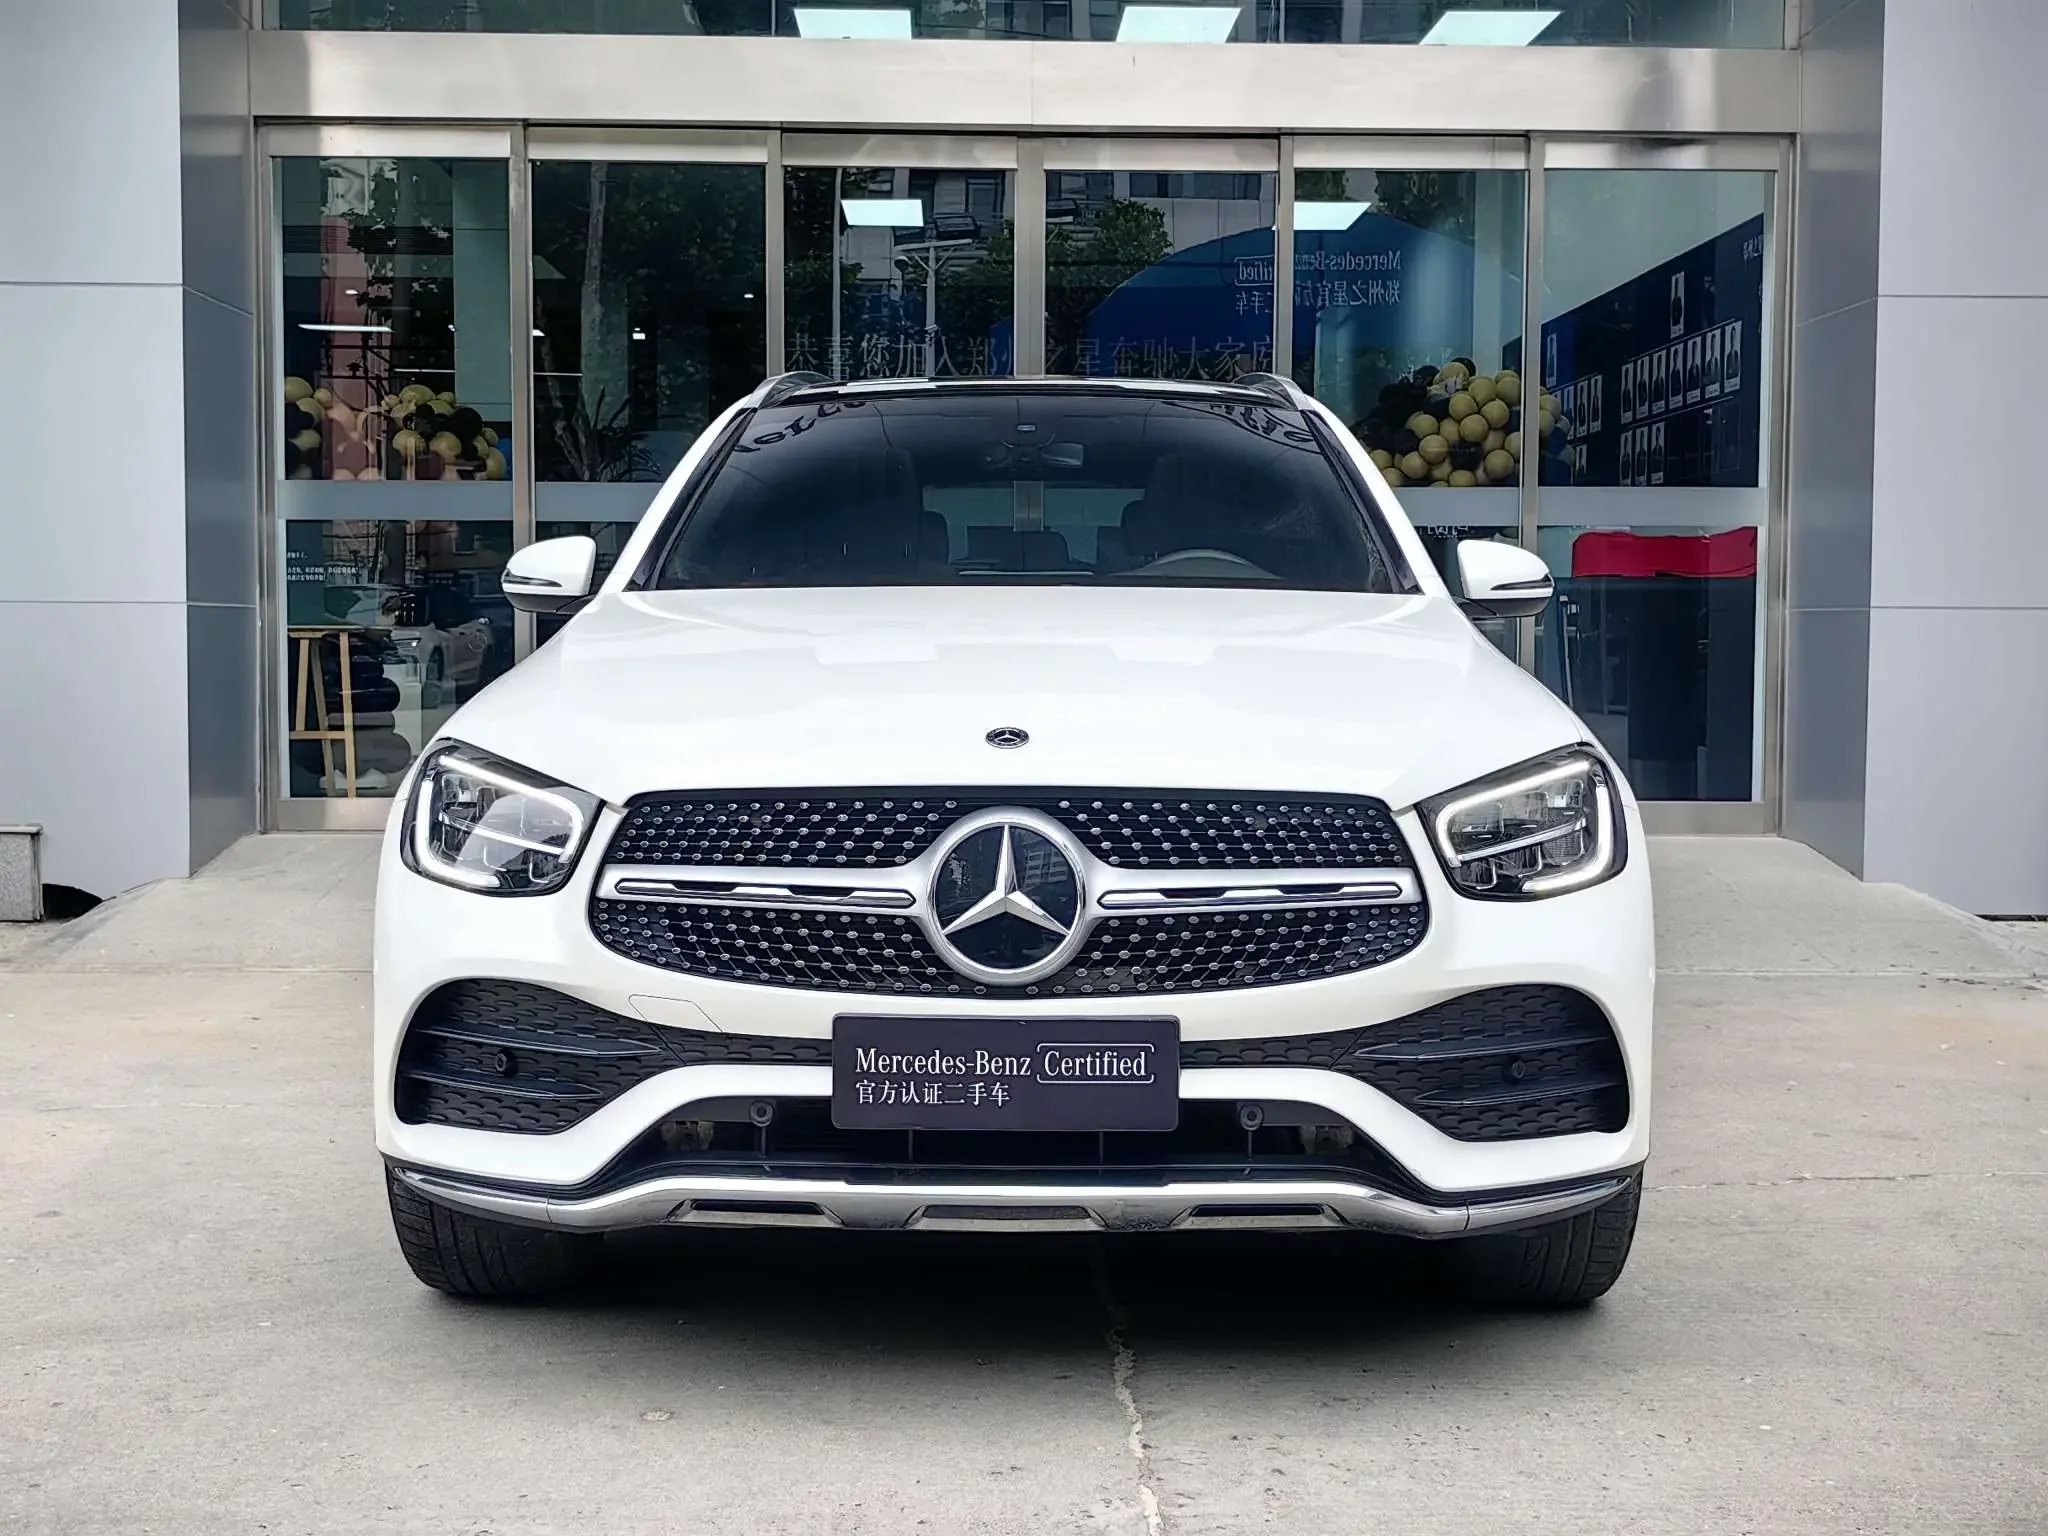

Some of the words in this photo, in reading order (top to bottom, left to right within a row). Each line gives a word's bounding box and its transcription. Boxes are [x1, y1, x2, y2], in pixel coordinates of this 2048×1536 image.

[855, 1047, 1031, 1076] Mercedes-Benz
[1044, 1050, 1147, 1077] Certified
[855, 1079, 1010, 1107] 官方认证二手车
